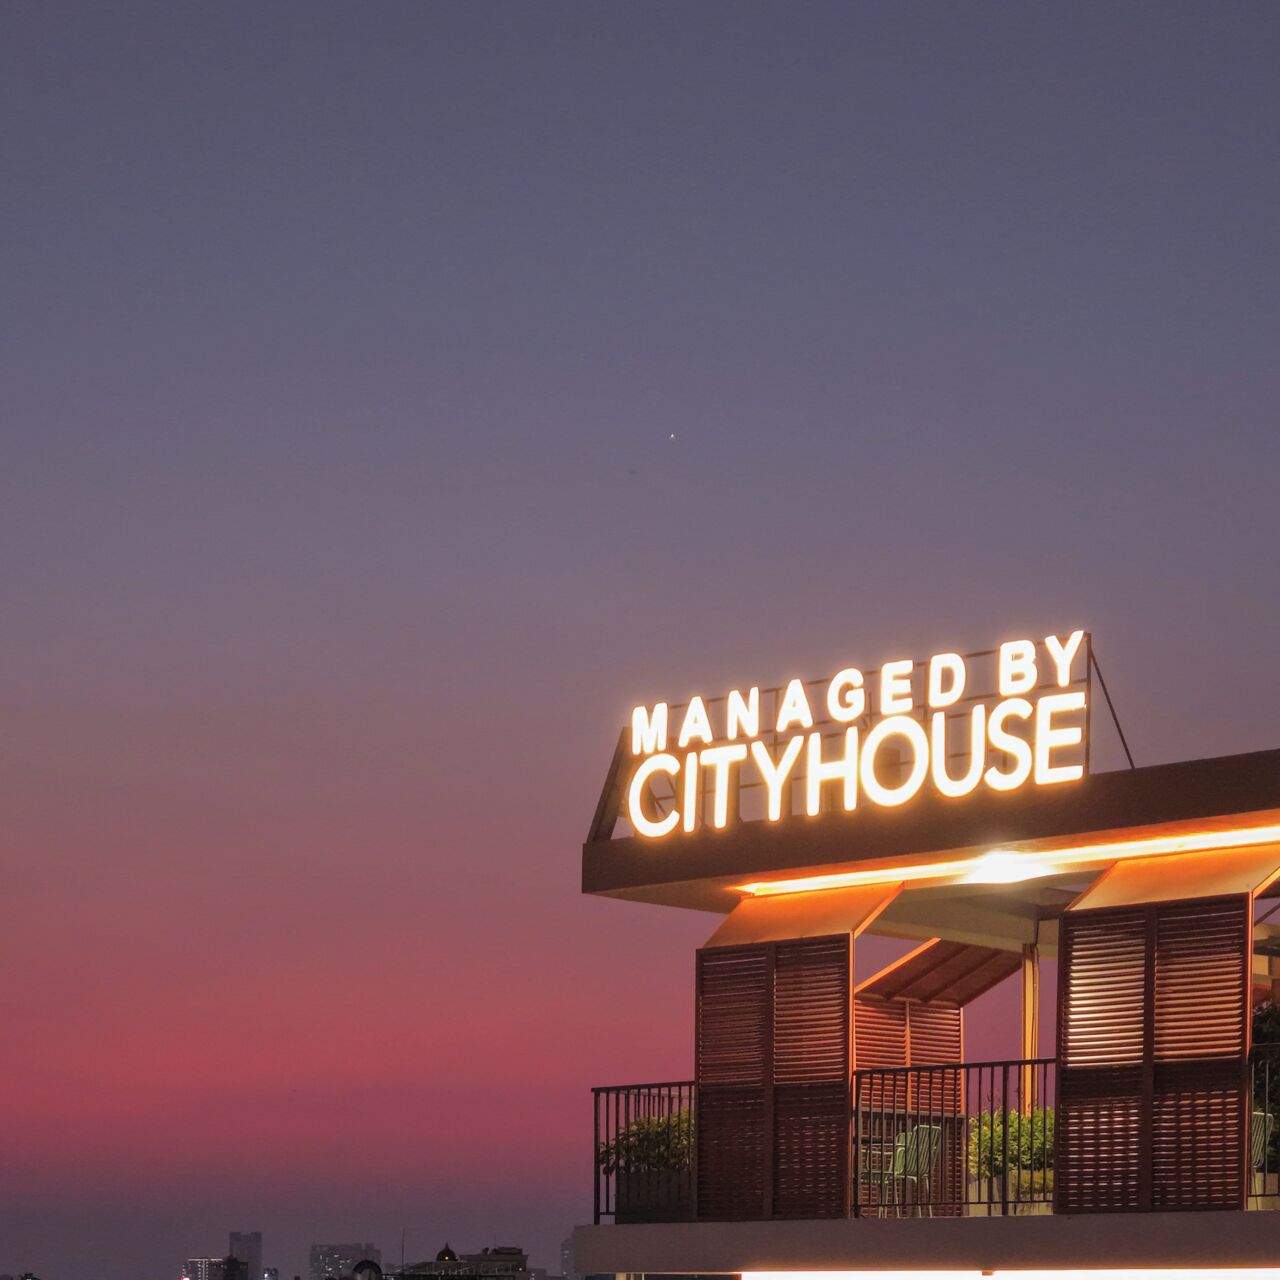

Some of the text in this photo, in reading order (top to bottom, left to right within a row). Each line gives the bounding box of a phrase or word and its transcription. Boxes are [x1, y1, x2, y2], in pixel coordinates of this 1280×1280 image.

[631, 630, 1086, 755] MANAGED BY
[628, 691, 1087, 838] CITYHOUSE
